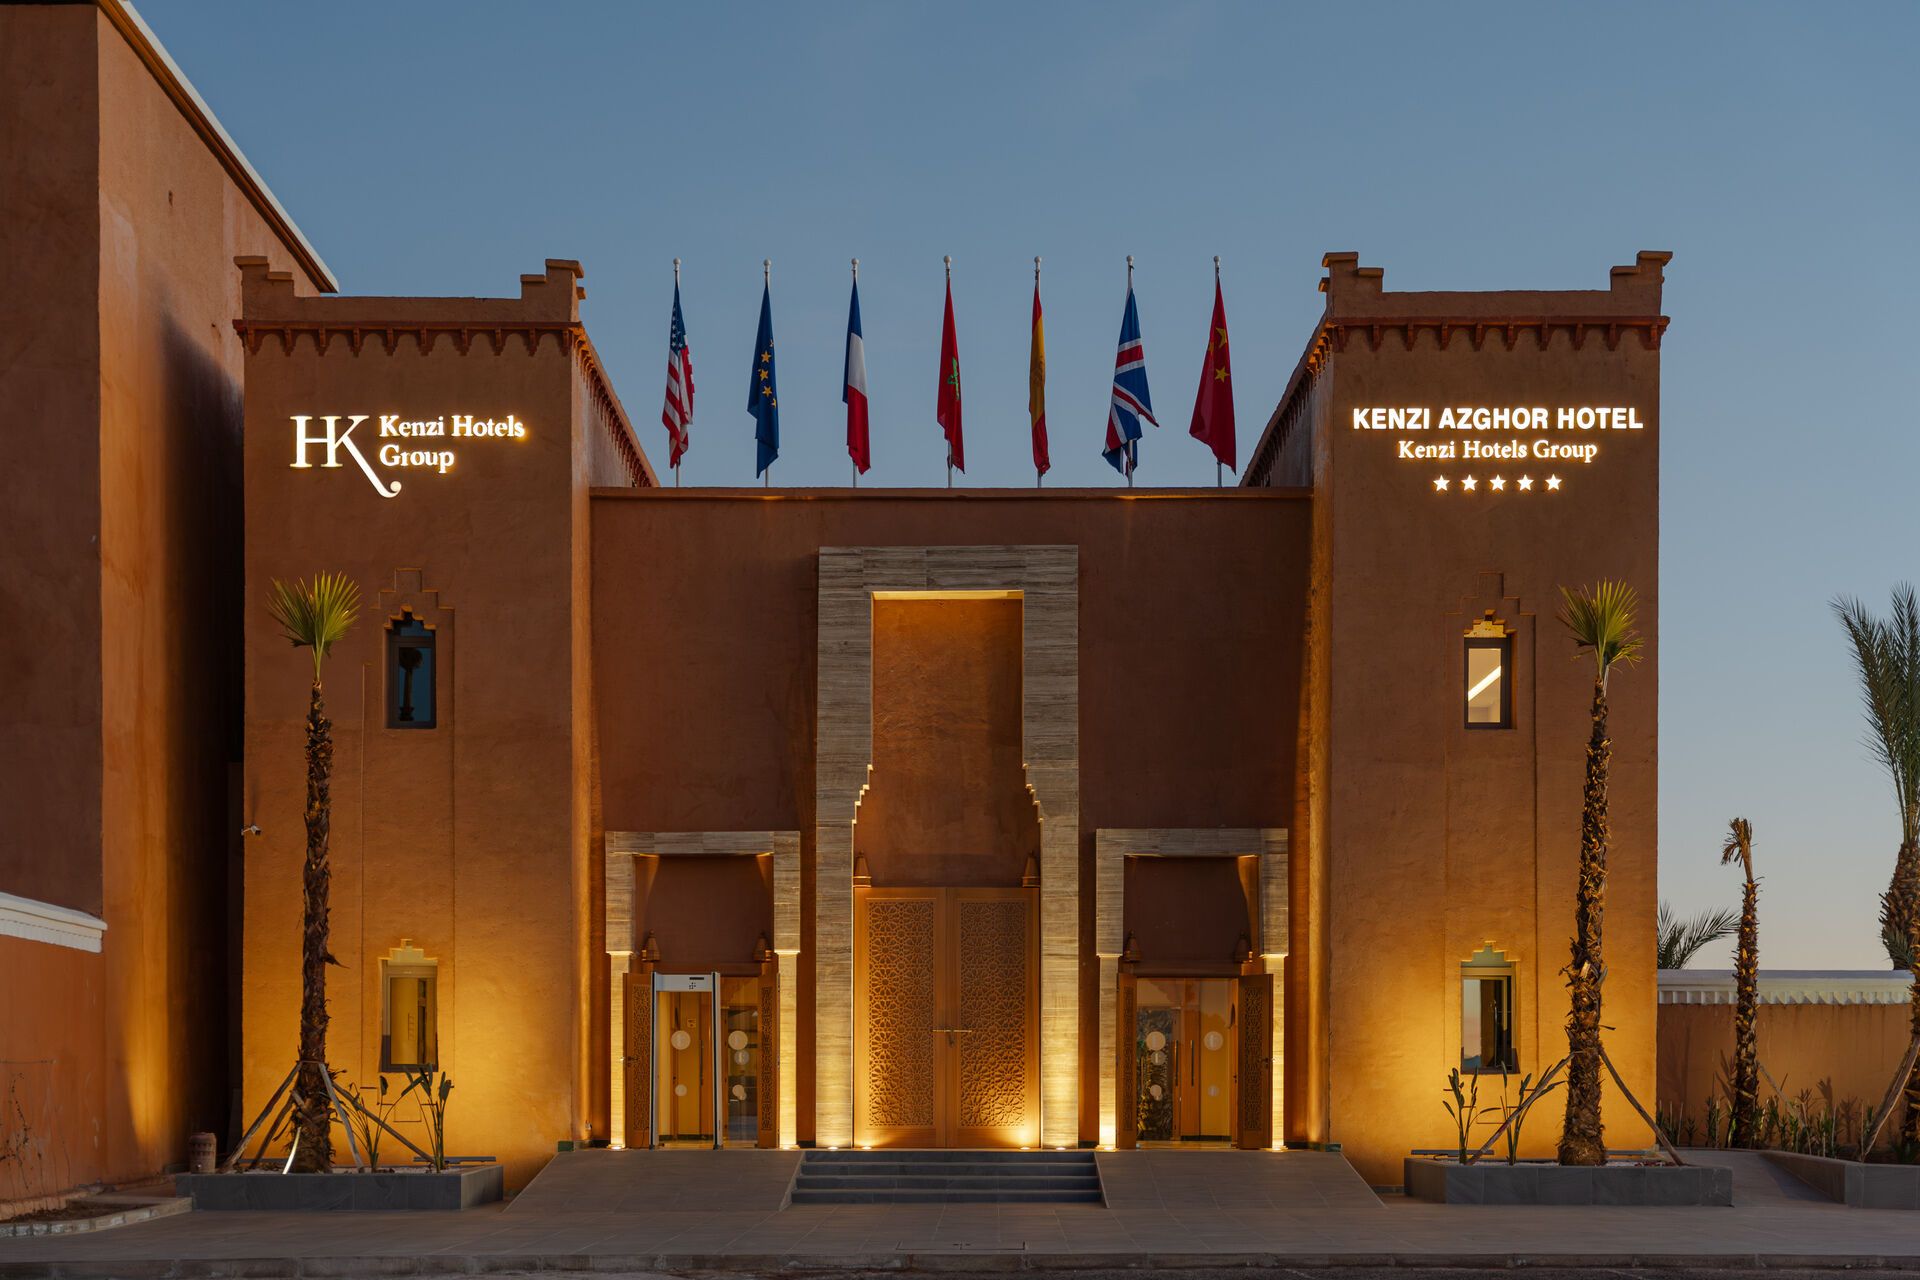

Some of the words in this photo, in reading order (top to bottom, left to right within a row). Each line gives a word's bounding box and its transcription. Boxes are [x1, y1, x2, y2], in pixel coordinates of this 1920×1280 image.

[379, 415, 445, 437] Kenzi
[451, 414, 526, 437] Hotels
[1353, 407, 1430, 430] KENZI
[1438, 407, 1549, 430] AZGHOR
[1557, 407, 1644, 430] HOTEL
[289, 415, 402, 498] HK
[379, 444, 455, 474] Group
[1398, 440, 1456, 459] Kenzi
[1462, 439, 1528, 459] Hotels
[1533, 439, 1598, 463] Group
